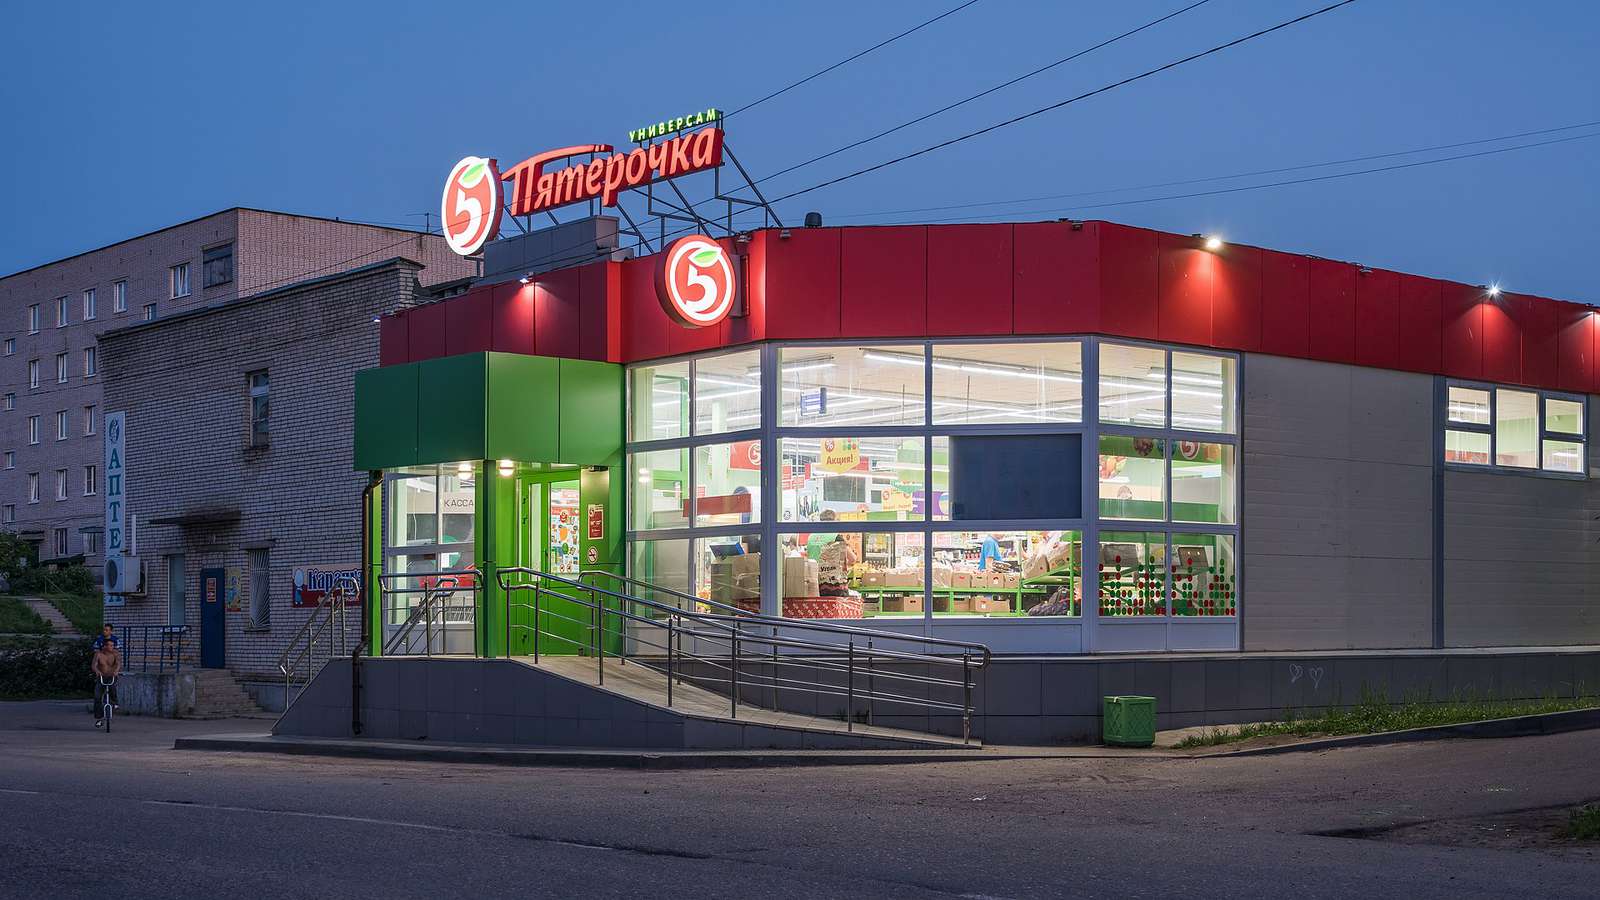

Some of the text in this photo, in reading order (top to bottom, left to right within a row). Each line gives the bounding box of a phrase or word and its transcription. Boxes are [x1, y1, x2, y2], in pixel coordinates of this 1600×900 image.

[628, 108, 716, 142] УНИВЕРСАМ
[501, 127, 718, 216] Пятёрочка
[826, 453, 854, 466] Акция!
[444, 499, 474, 507] КАССА
